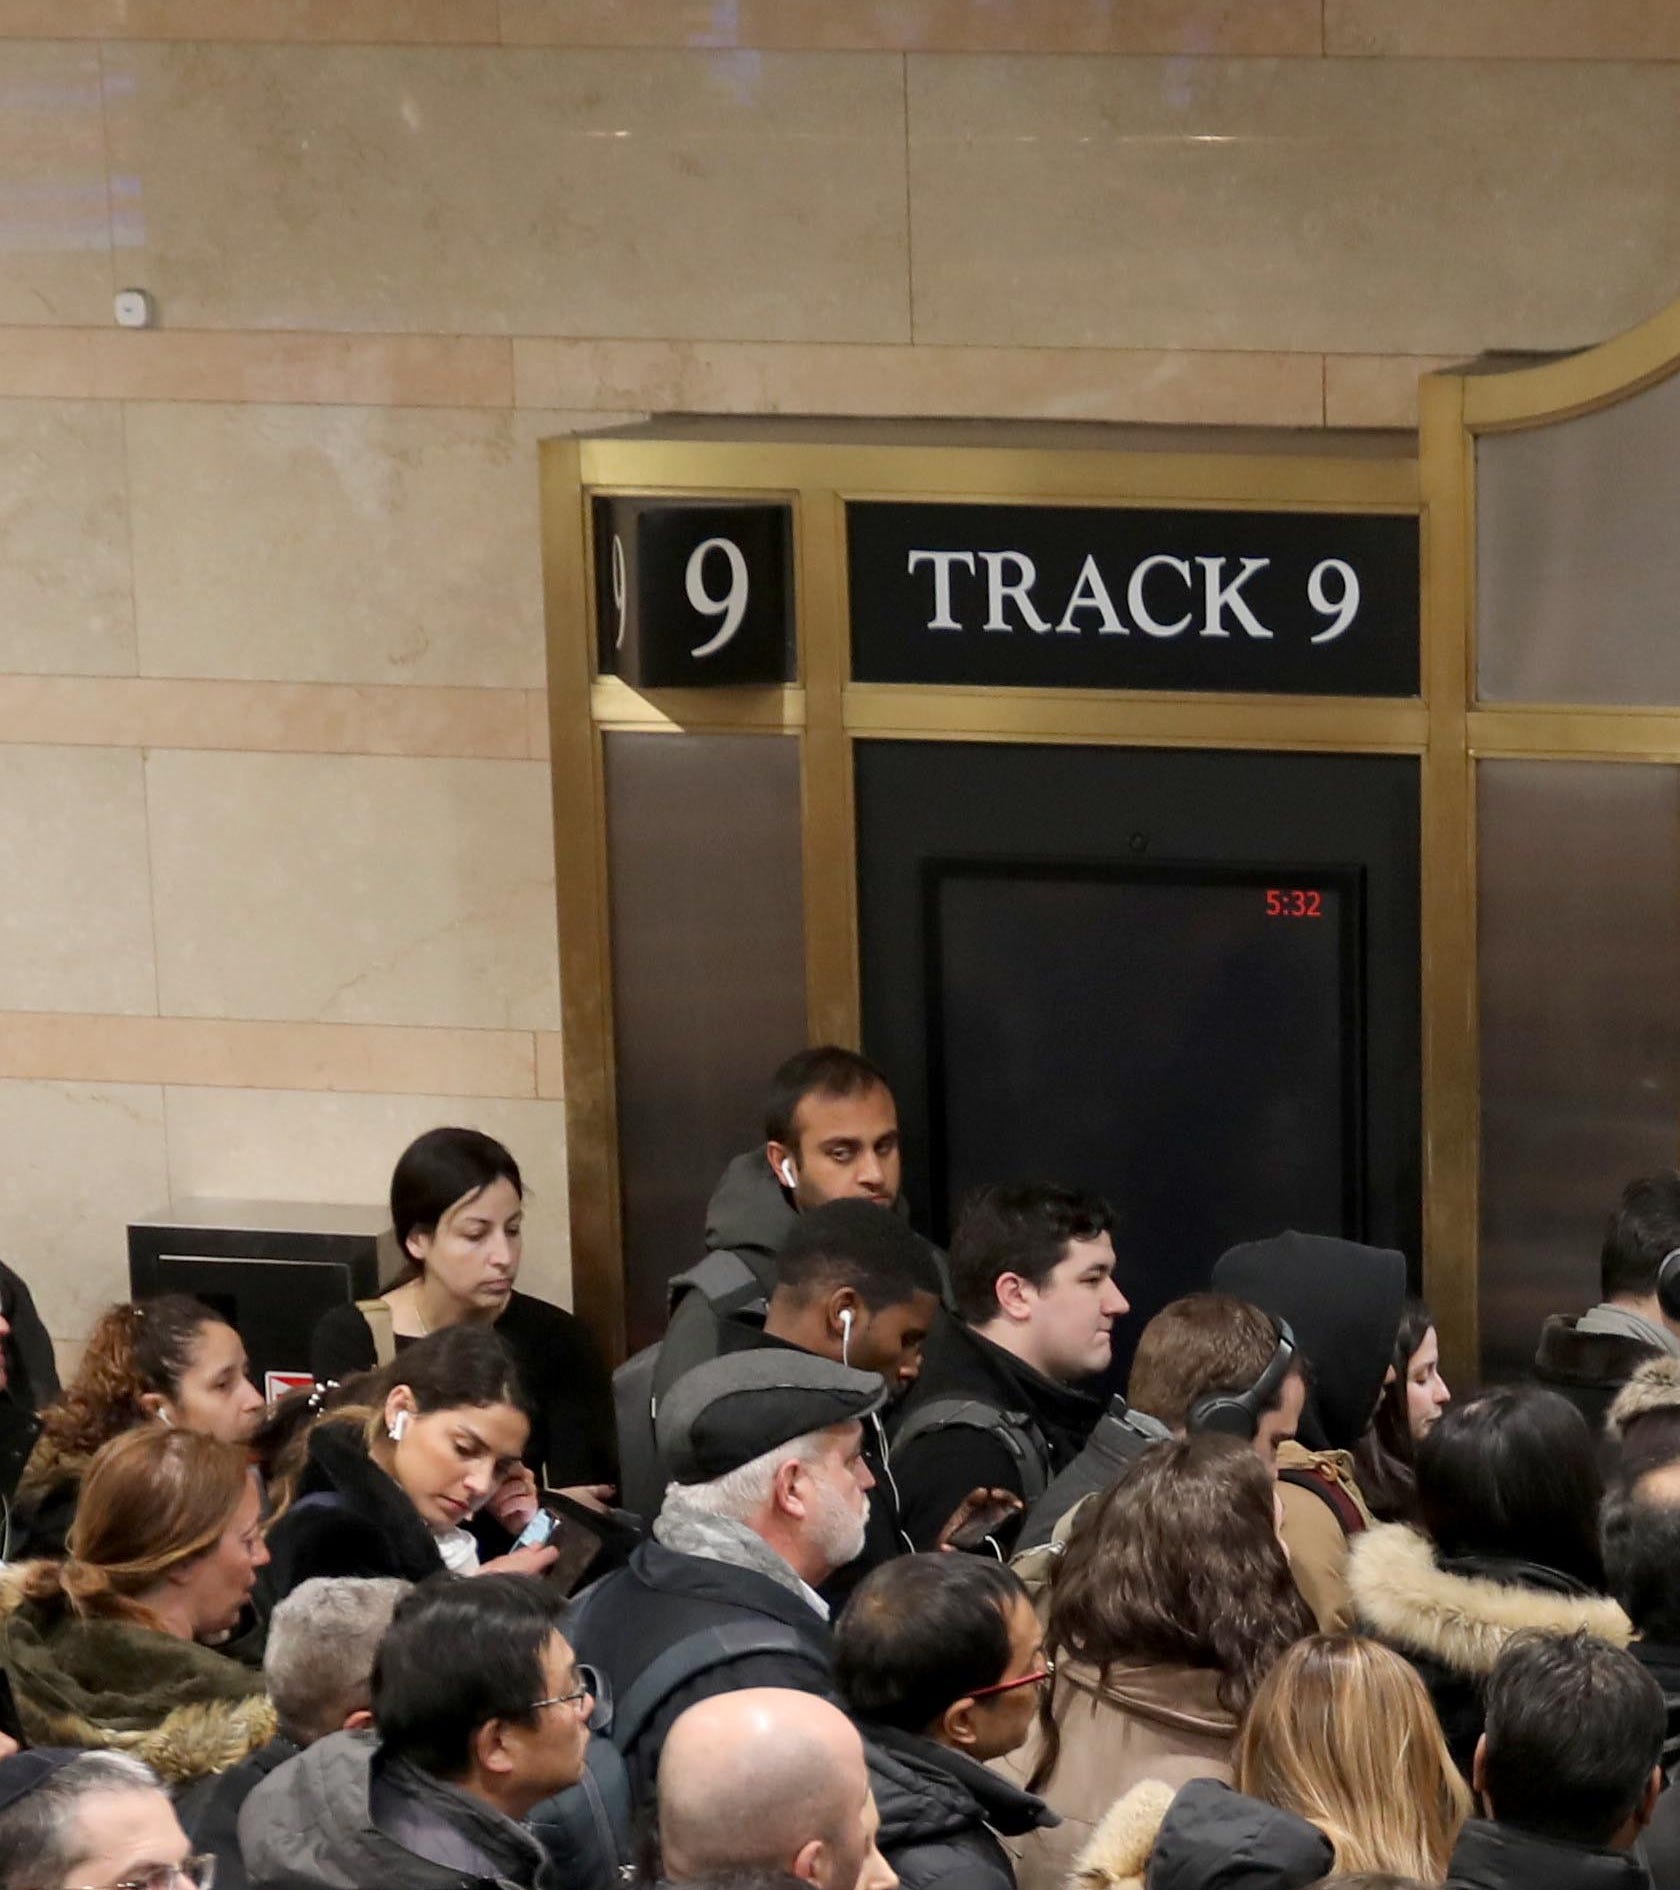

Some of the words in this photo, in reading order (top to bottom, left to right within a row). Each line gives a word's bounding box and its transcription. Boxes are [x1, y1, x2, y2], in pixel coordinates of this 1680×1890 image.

[685, 537, 749, 657] 9
[907, 549, 1274, 639] TRACK
[1307, 557, 1361, 644] 9
[1265, 889, 1323, 917] 5:32
